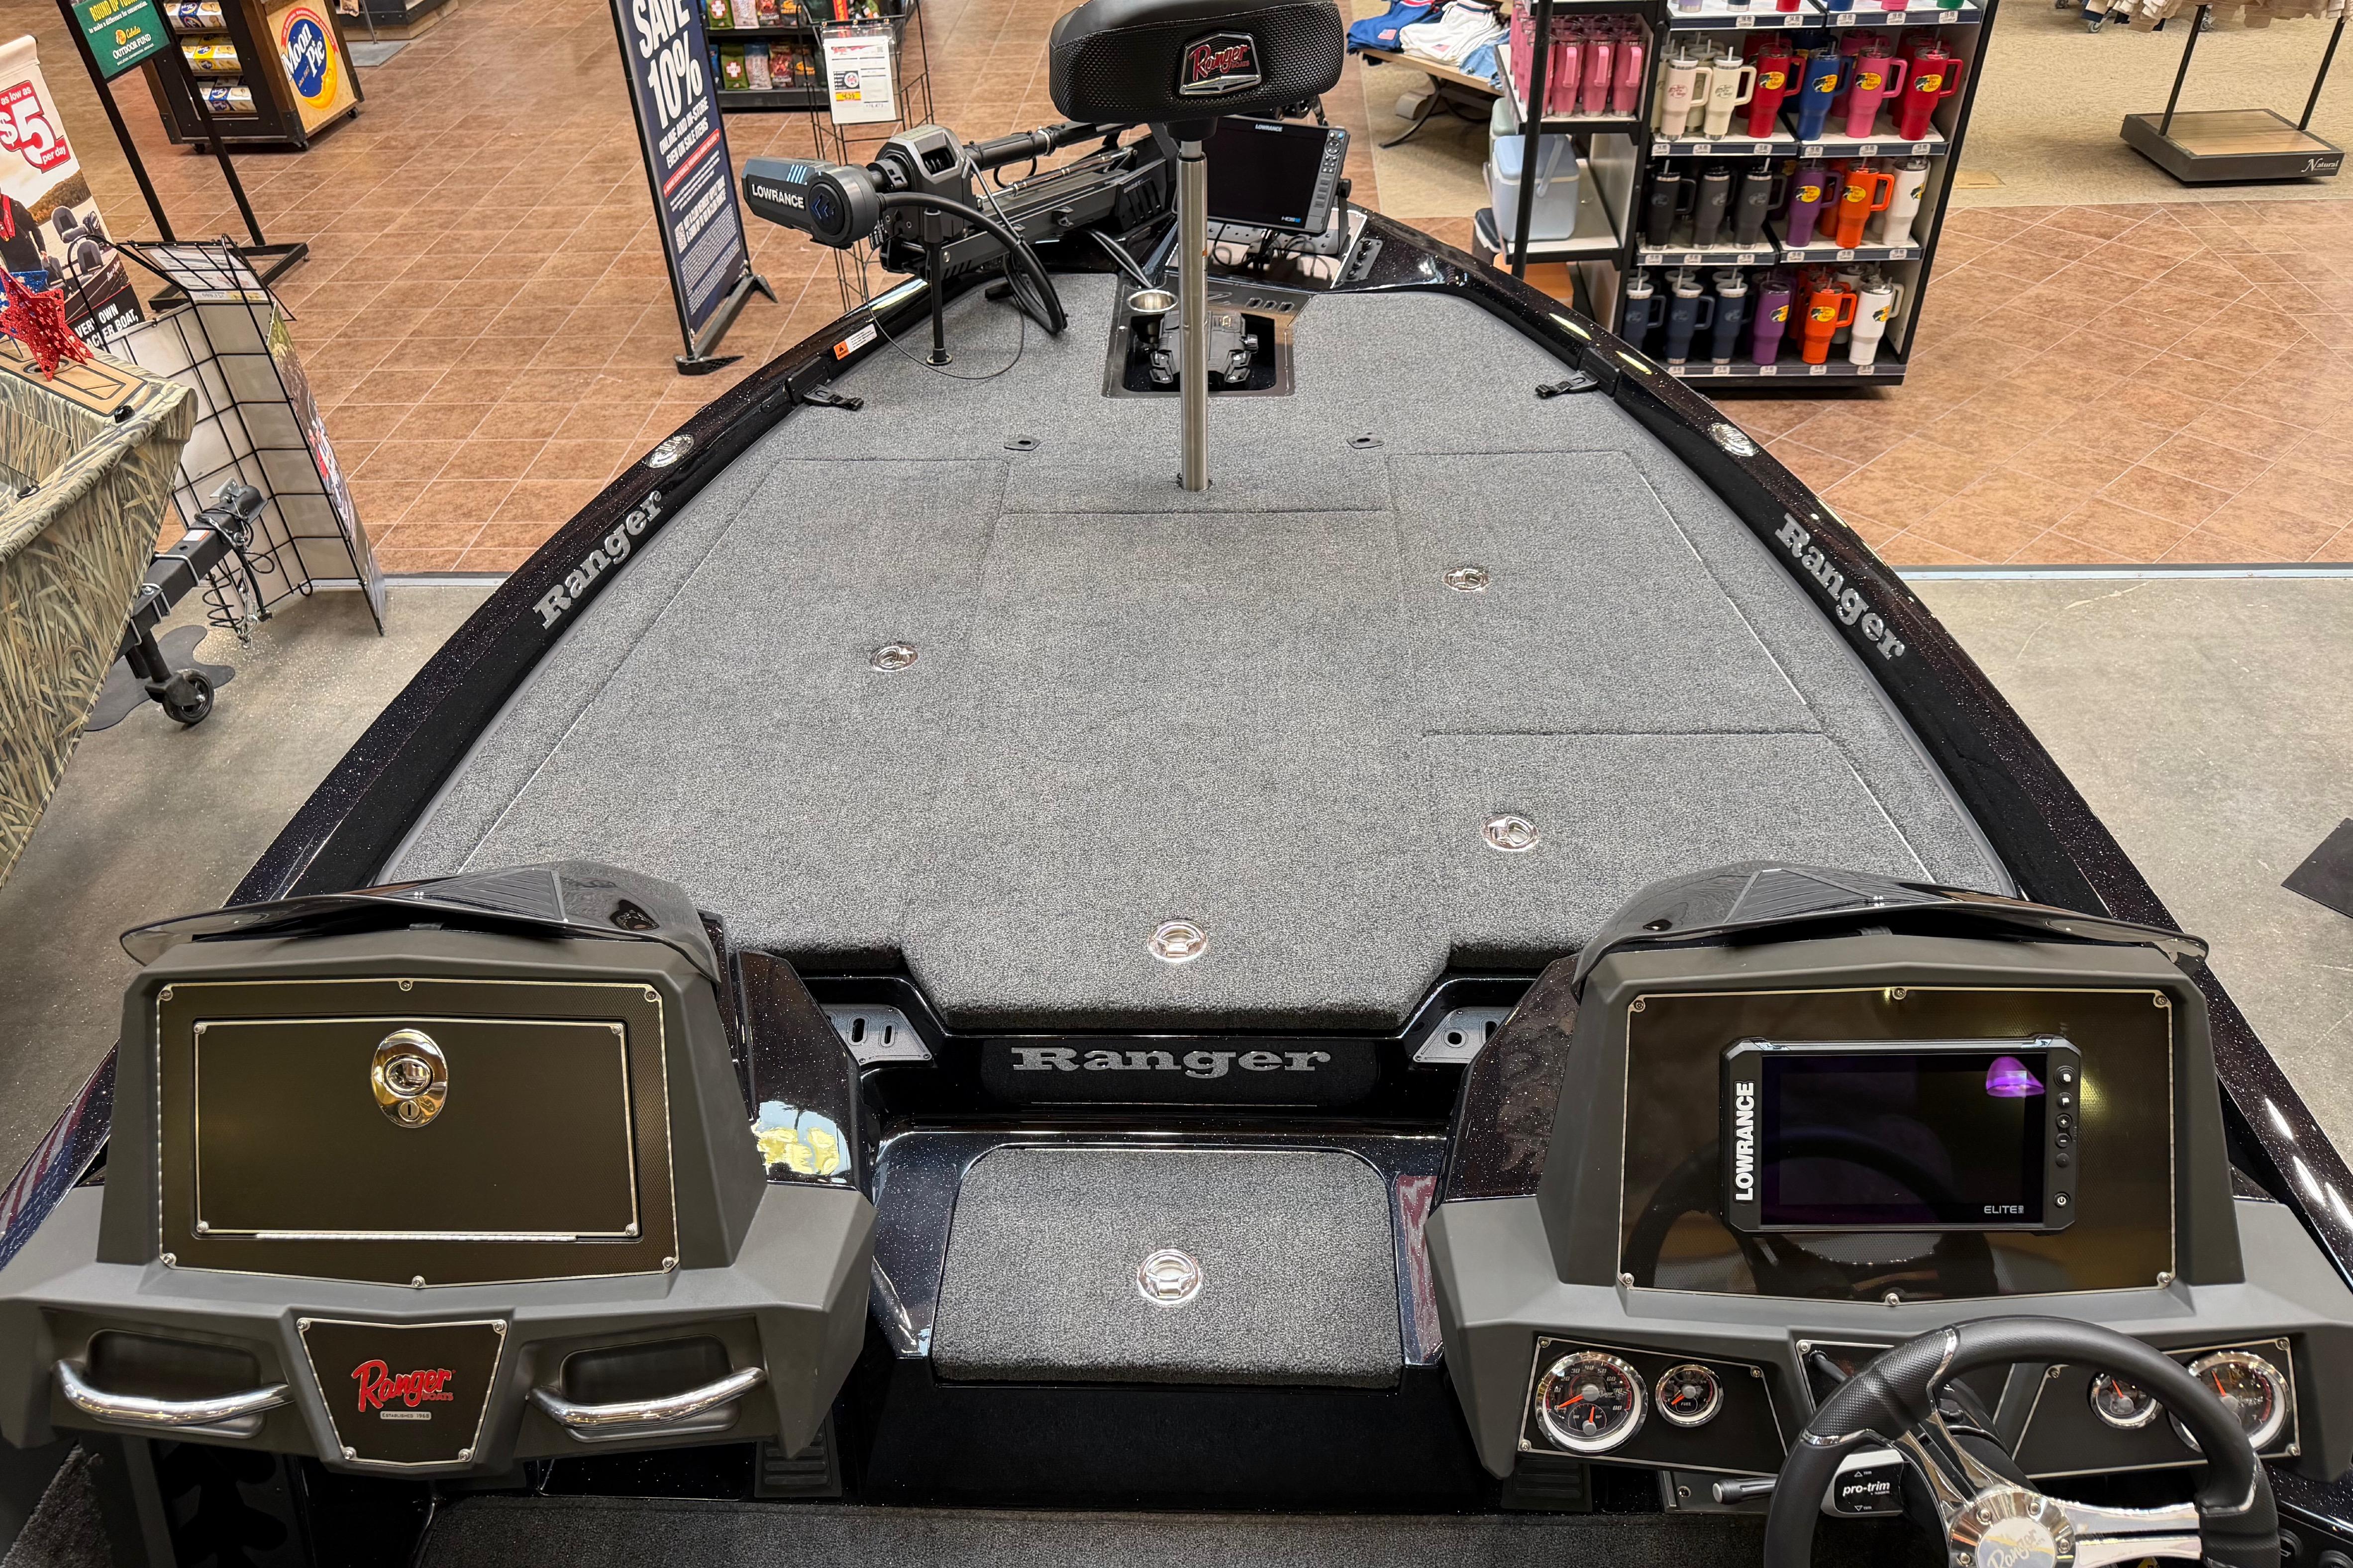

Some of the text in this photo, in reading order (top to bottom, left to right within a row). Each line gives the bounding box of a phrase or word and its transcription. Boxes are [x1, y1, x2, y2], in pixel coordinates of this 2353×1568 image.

[89, 0, 112, 21] ROUND
[113, 40, 138, 59] OUTDOOR
[137, 34, 151, 47] FUND
[281, 23, 312, 82] Moon
[306, 40, 325, 78] Pie
[1188, 44, 1249, 81] Ranger
[1, 87, 32, 105] as low as
[647, 30, 703, 129] 10%
[0, 96, 55, 164] $5
[659, 96, 709, 155] ONLINE AND IN-STORE
[1255, 123, 1283, 132] LOWRANCE
[42, 145, 66, 165] per day
[666, 147, 680, 169] EVEN
[684, 129, 697, 151] SALE
[694, 116, 709, 140] ITEMS
[2301, 158, 2339, 173] Natural
[752, 183, 805, 209] LOWRANCE
[99, 303, 119, 324] OWN
[114, 308, 138, 332] BOAT,
[532, 490, 662, 631] Ranger
[1774, 512, 1905, 661] Ranger
[1011, 1046, 1332, 1079] Ranger
[1735, 1080, 1754, 1201] LOWRANCE
[351, 1359, 452, 1412] Ranger
[421, 1392, 454, 1401] BOATS
[1842, 1481, 1890, 1497] pro-trim
